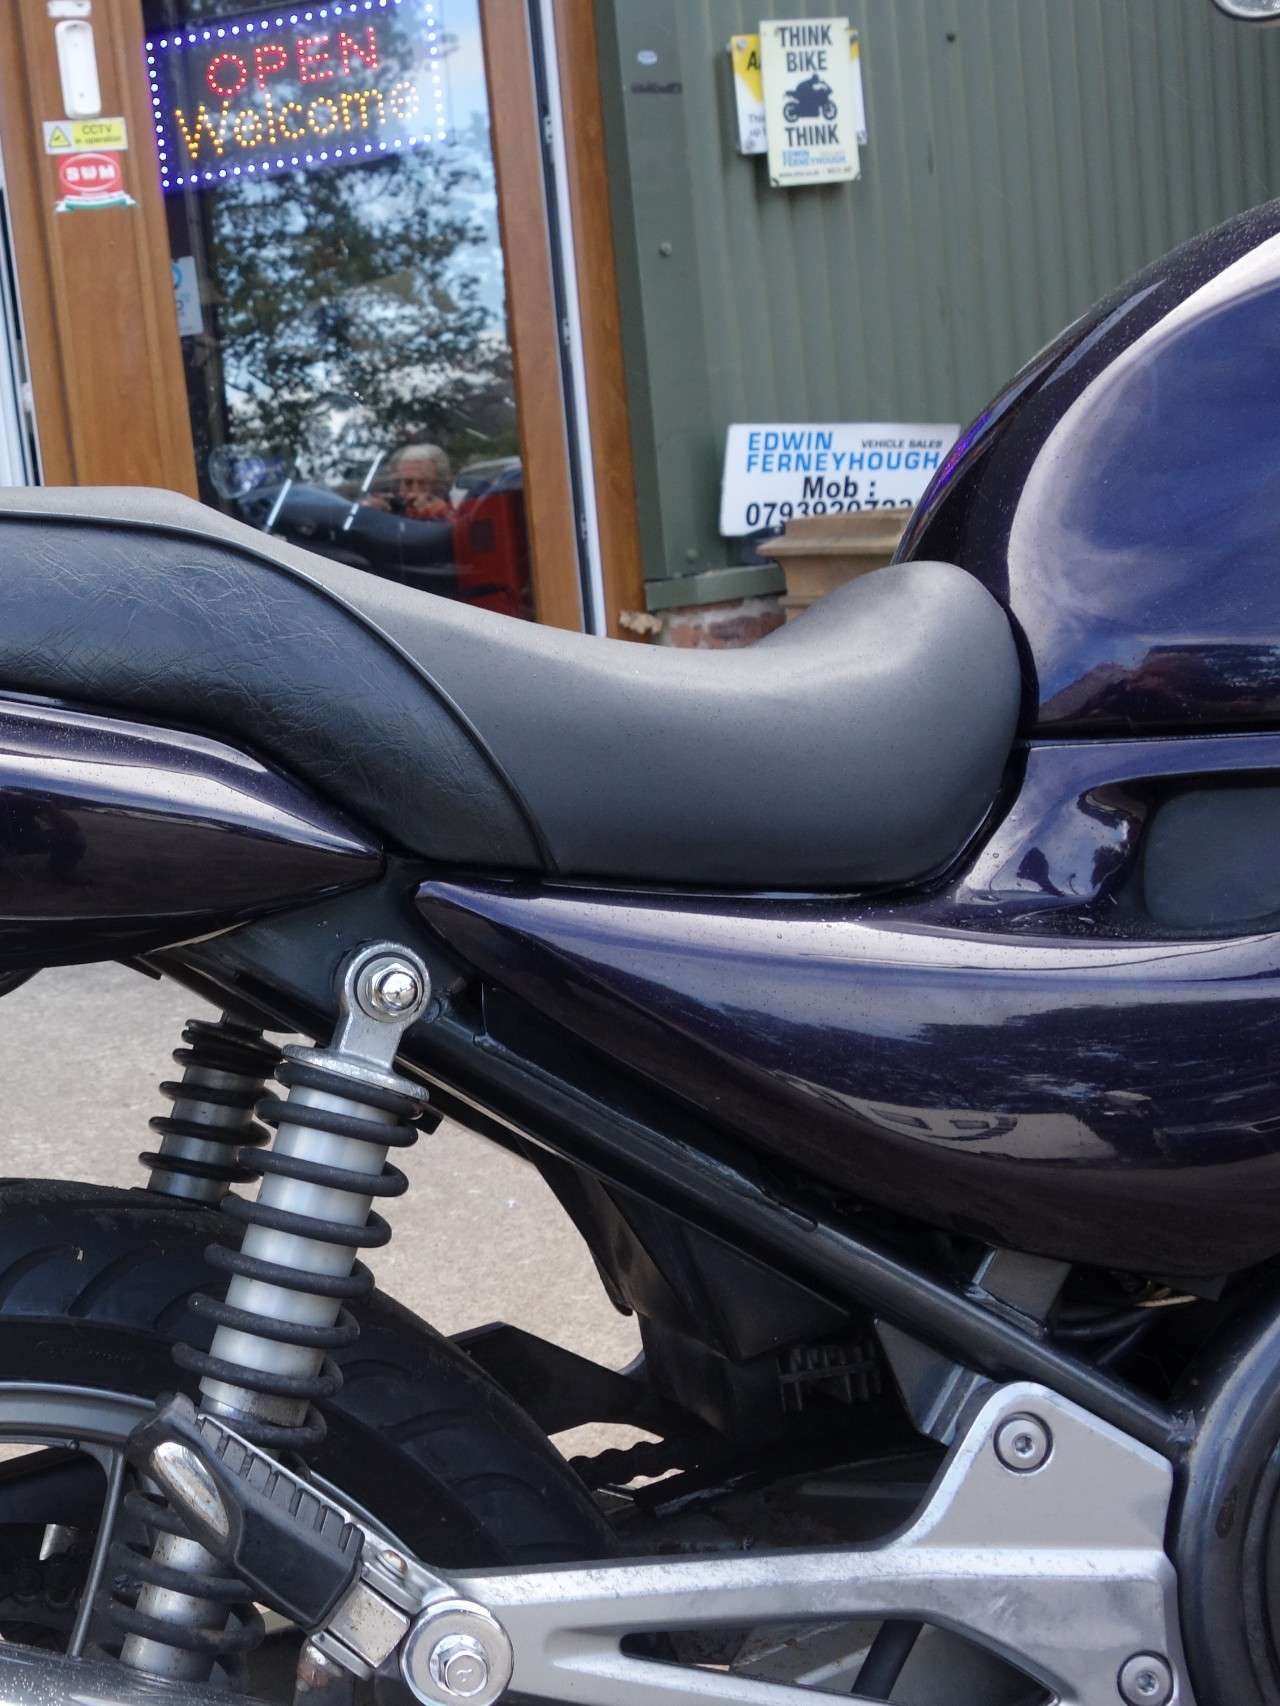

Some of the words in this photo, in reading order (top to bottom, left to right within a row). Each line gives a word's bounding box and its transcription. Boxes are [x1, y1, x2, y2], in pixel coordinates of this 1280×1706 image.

[778, 24, 832, 47] THINK
[207, 26, 379, 96] OPEN
[786, 51, 828, 72] BIKE
[81, 123, 113, 135] CCTV
[175, 81, 420, 159] Welcome
[784, 124, 839, 147] THINK
[748, 432, 833, 451] EDWIN
[861, 440, 905, 449] VEHICLE
[909, 439, 943, 449] SALES
[747, 451, 939, 473] FERNEYHOUGH
[803, 475, 858, 499] Mob
